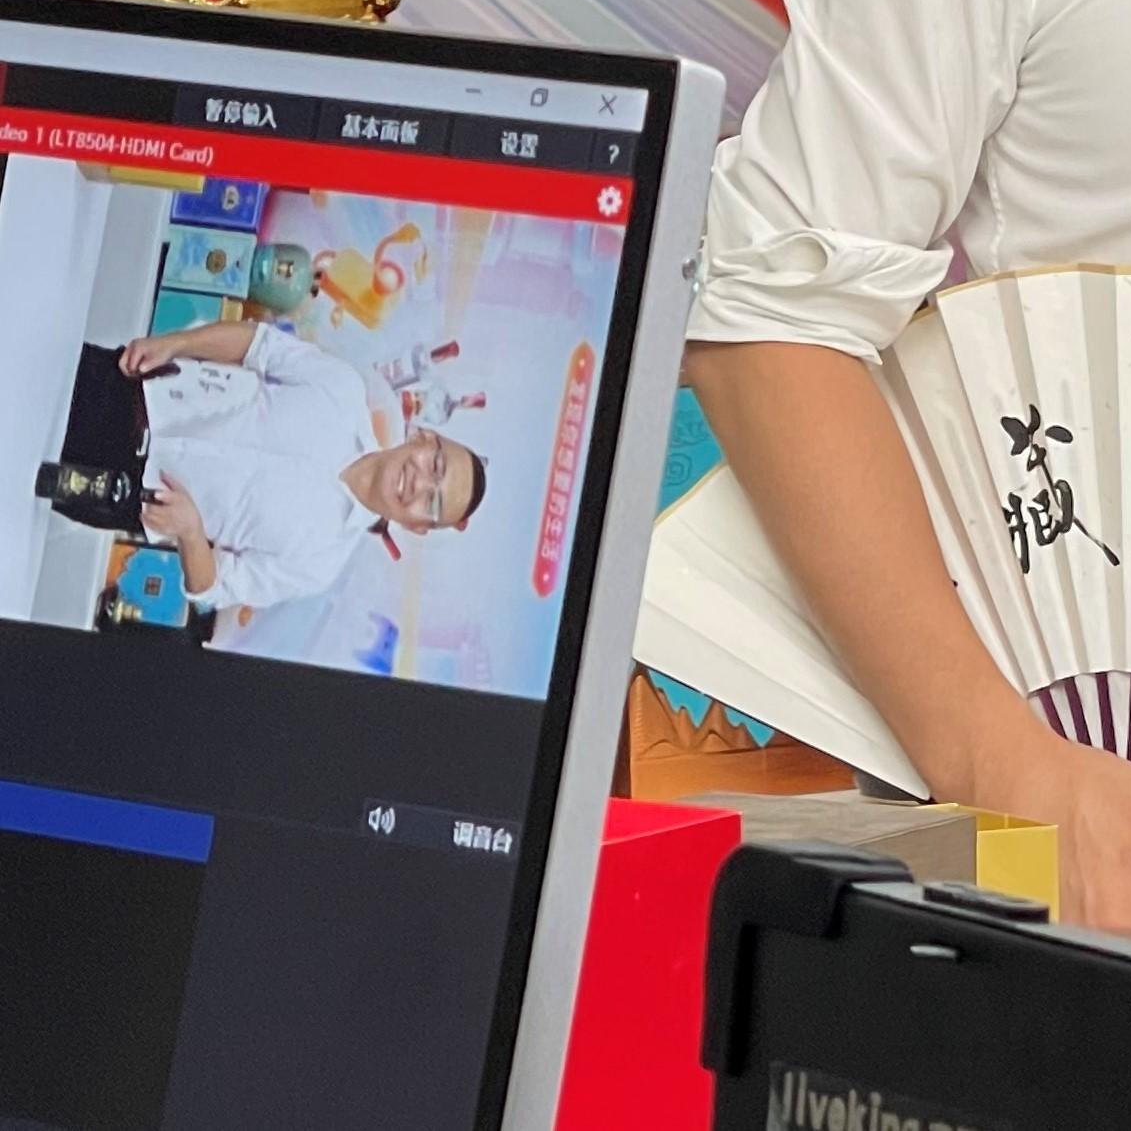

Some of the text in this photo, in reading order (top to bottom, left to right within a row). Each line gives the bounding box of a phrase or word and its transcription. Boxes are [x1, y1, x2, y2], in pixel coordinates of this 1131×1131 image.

[341, 112, 420, 146] 基本面板
[501, 130, 540, 159] 设置
[36, 126, 43, 144] 1
[169, 145, 214, 167] Card)
